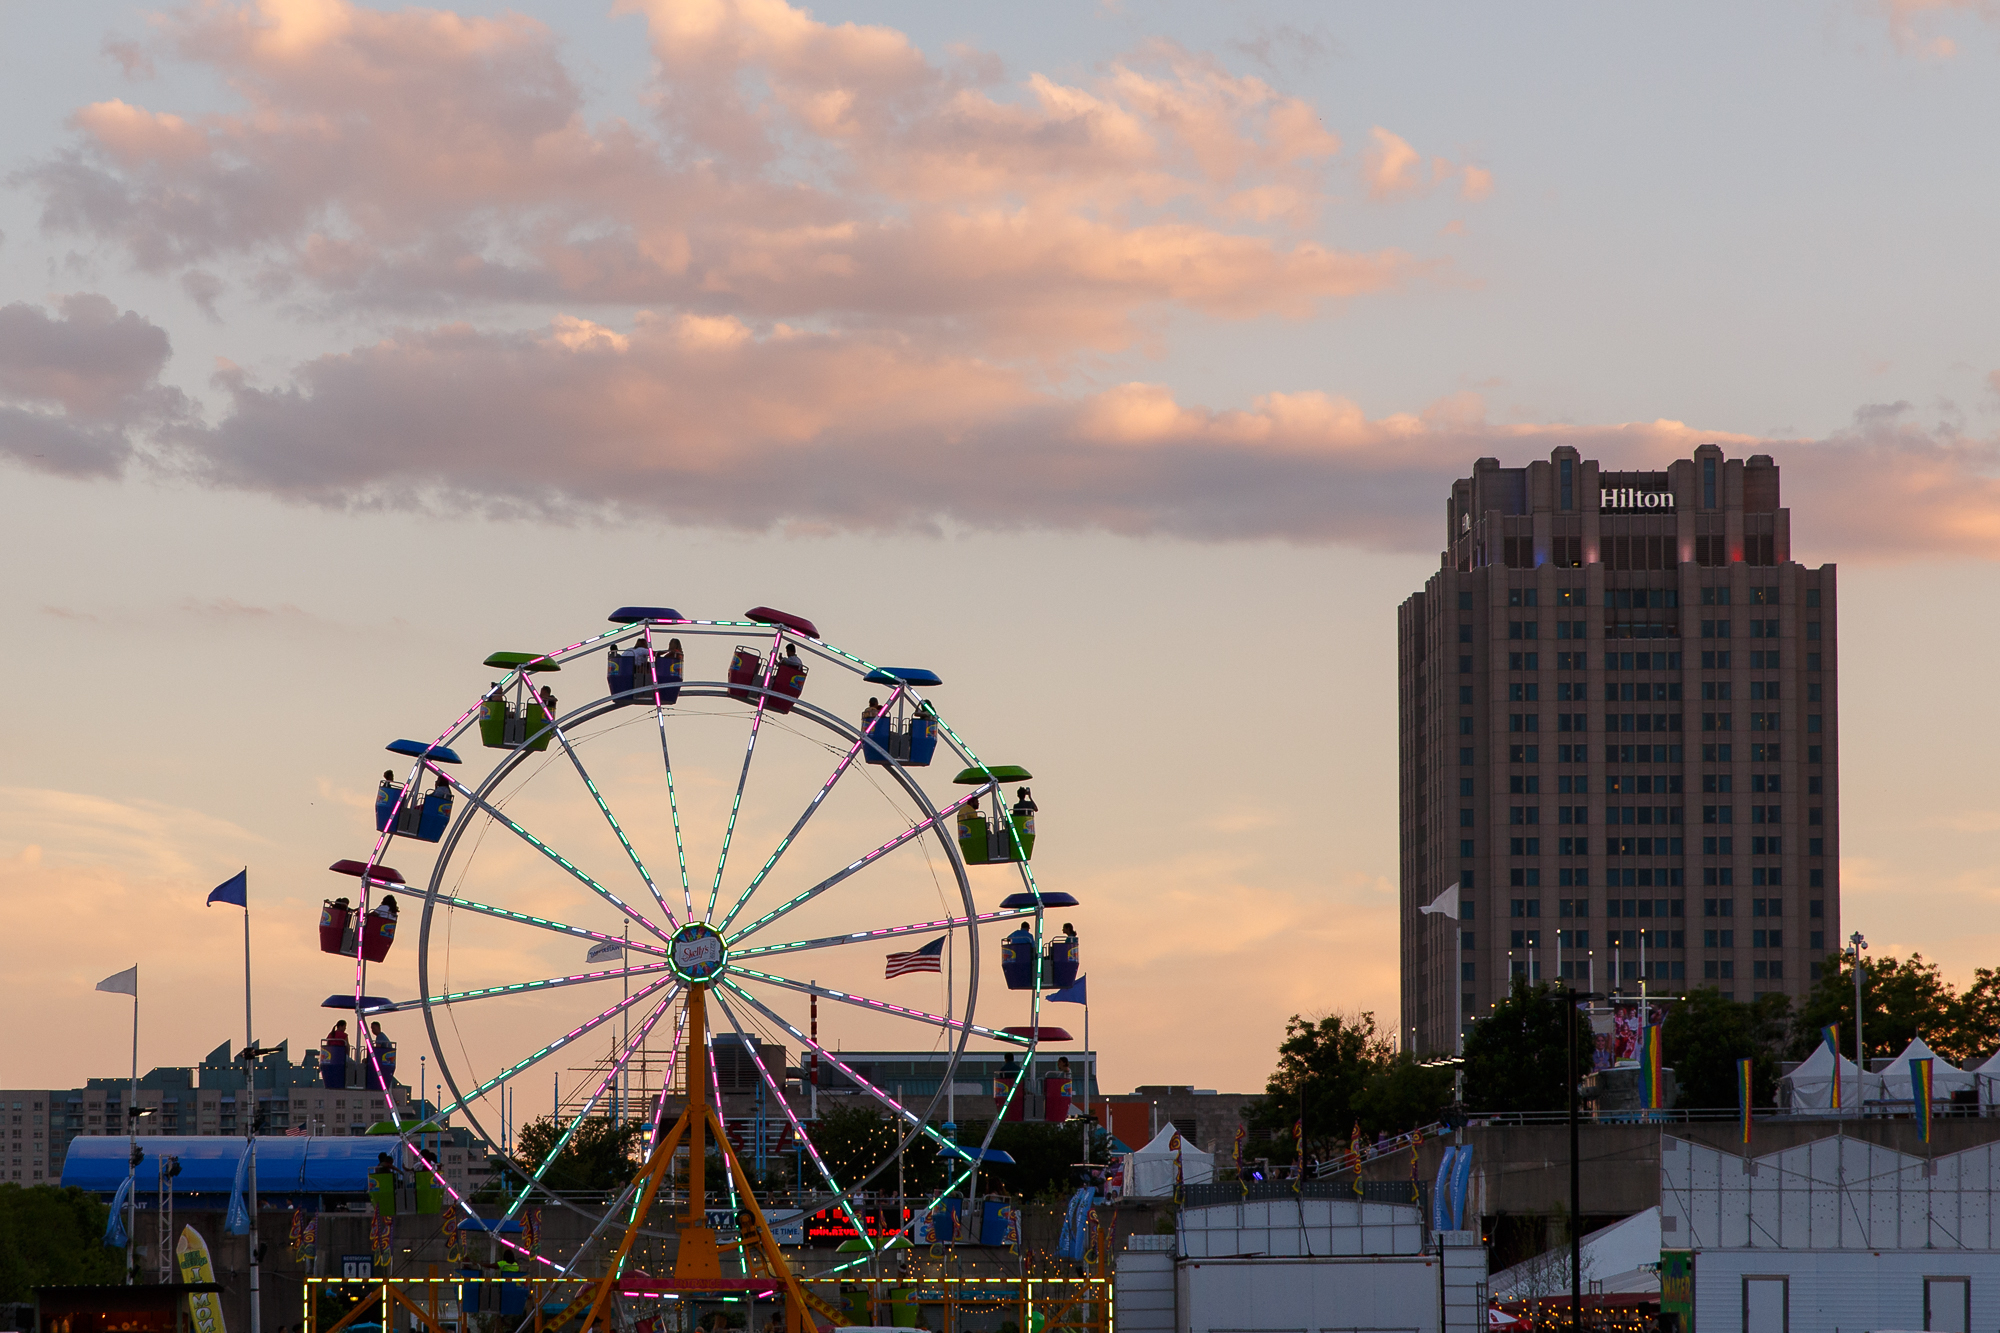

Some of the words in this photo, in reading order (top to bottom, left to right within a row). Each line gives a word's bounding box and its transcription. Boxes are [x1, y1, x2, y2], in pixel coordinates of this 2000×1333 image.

[1600, 488, 1675, 508] Hilton
[681, 945, 709, 963] Skelly's
[673, 1279, 721, 1288] ENTRANCE
[1662, 1274, 1691, 1304] WATER
[190, 1267, 217, 1333] LMON
